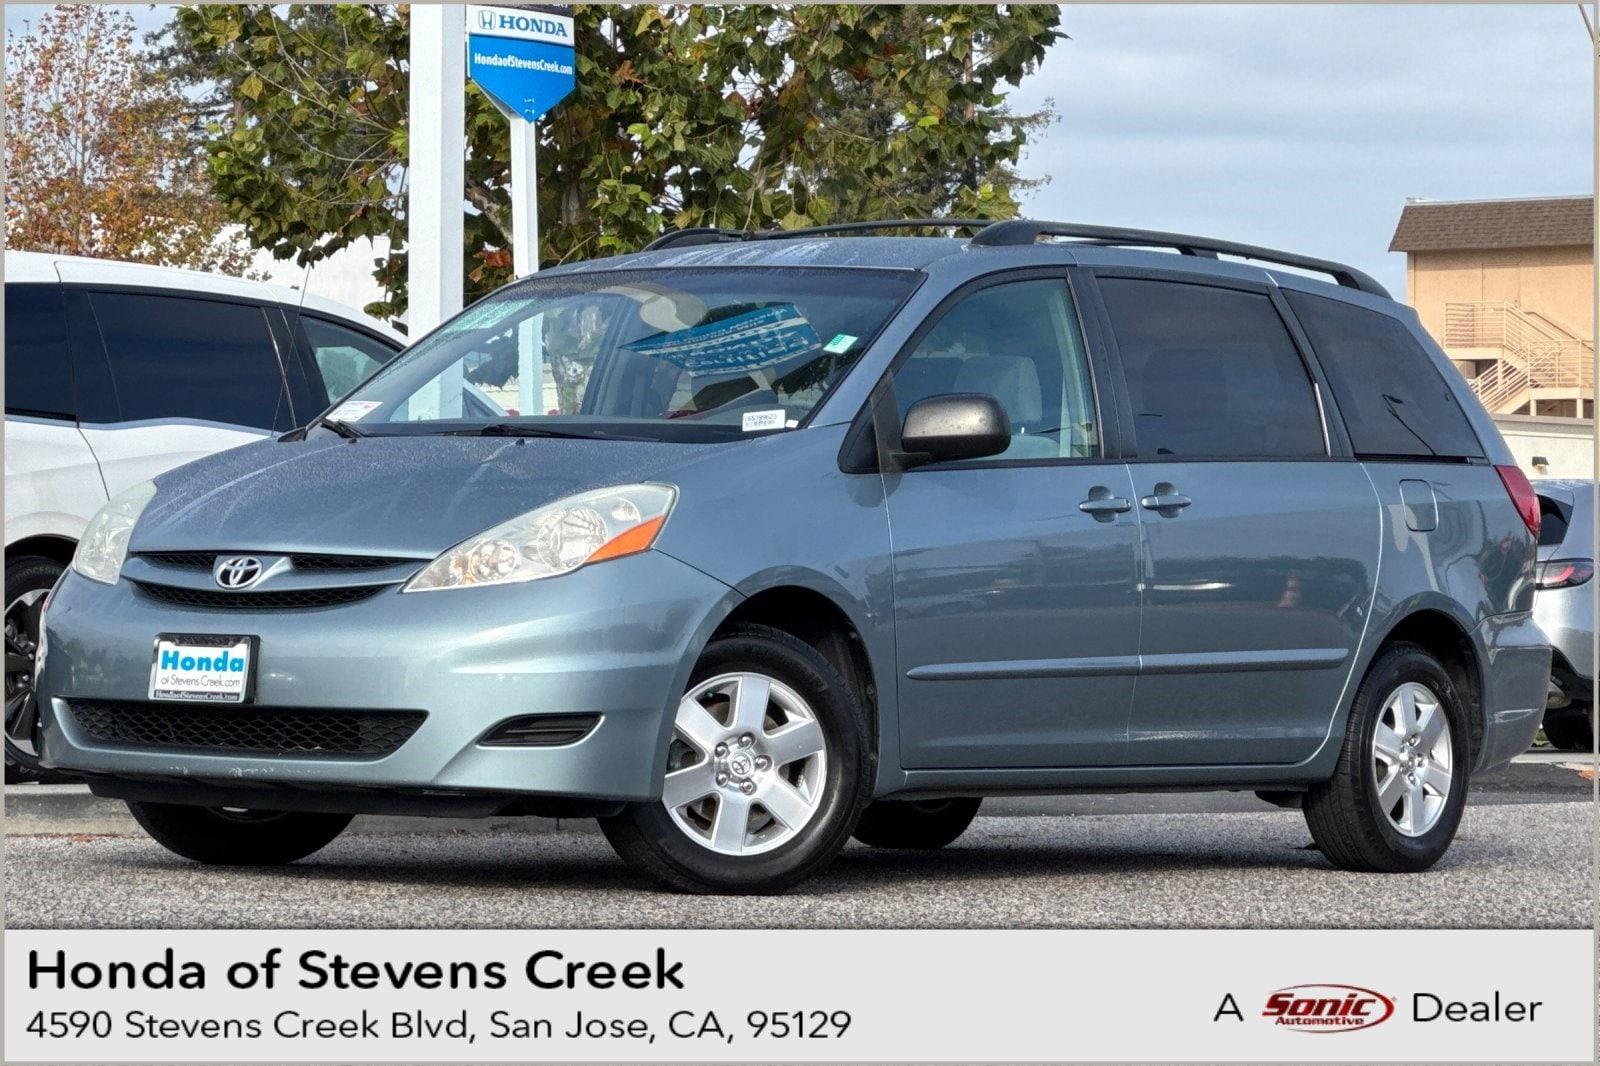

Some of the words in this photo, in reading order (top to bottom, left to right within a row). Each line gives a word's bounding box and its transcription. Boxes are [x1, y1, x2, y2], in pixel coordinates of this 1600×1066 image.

[498, 14, 568, 37] HONDA
[474, 52, 573, 75] HondaofStevensCreek.com
[161, 650, 244, 672] Honda
[161, 677, 171, 685] of
[171, 674, 200, 686] Stevens
[201, 675, 241, 687] Creek.com
